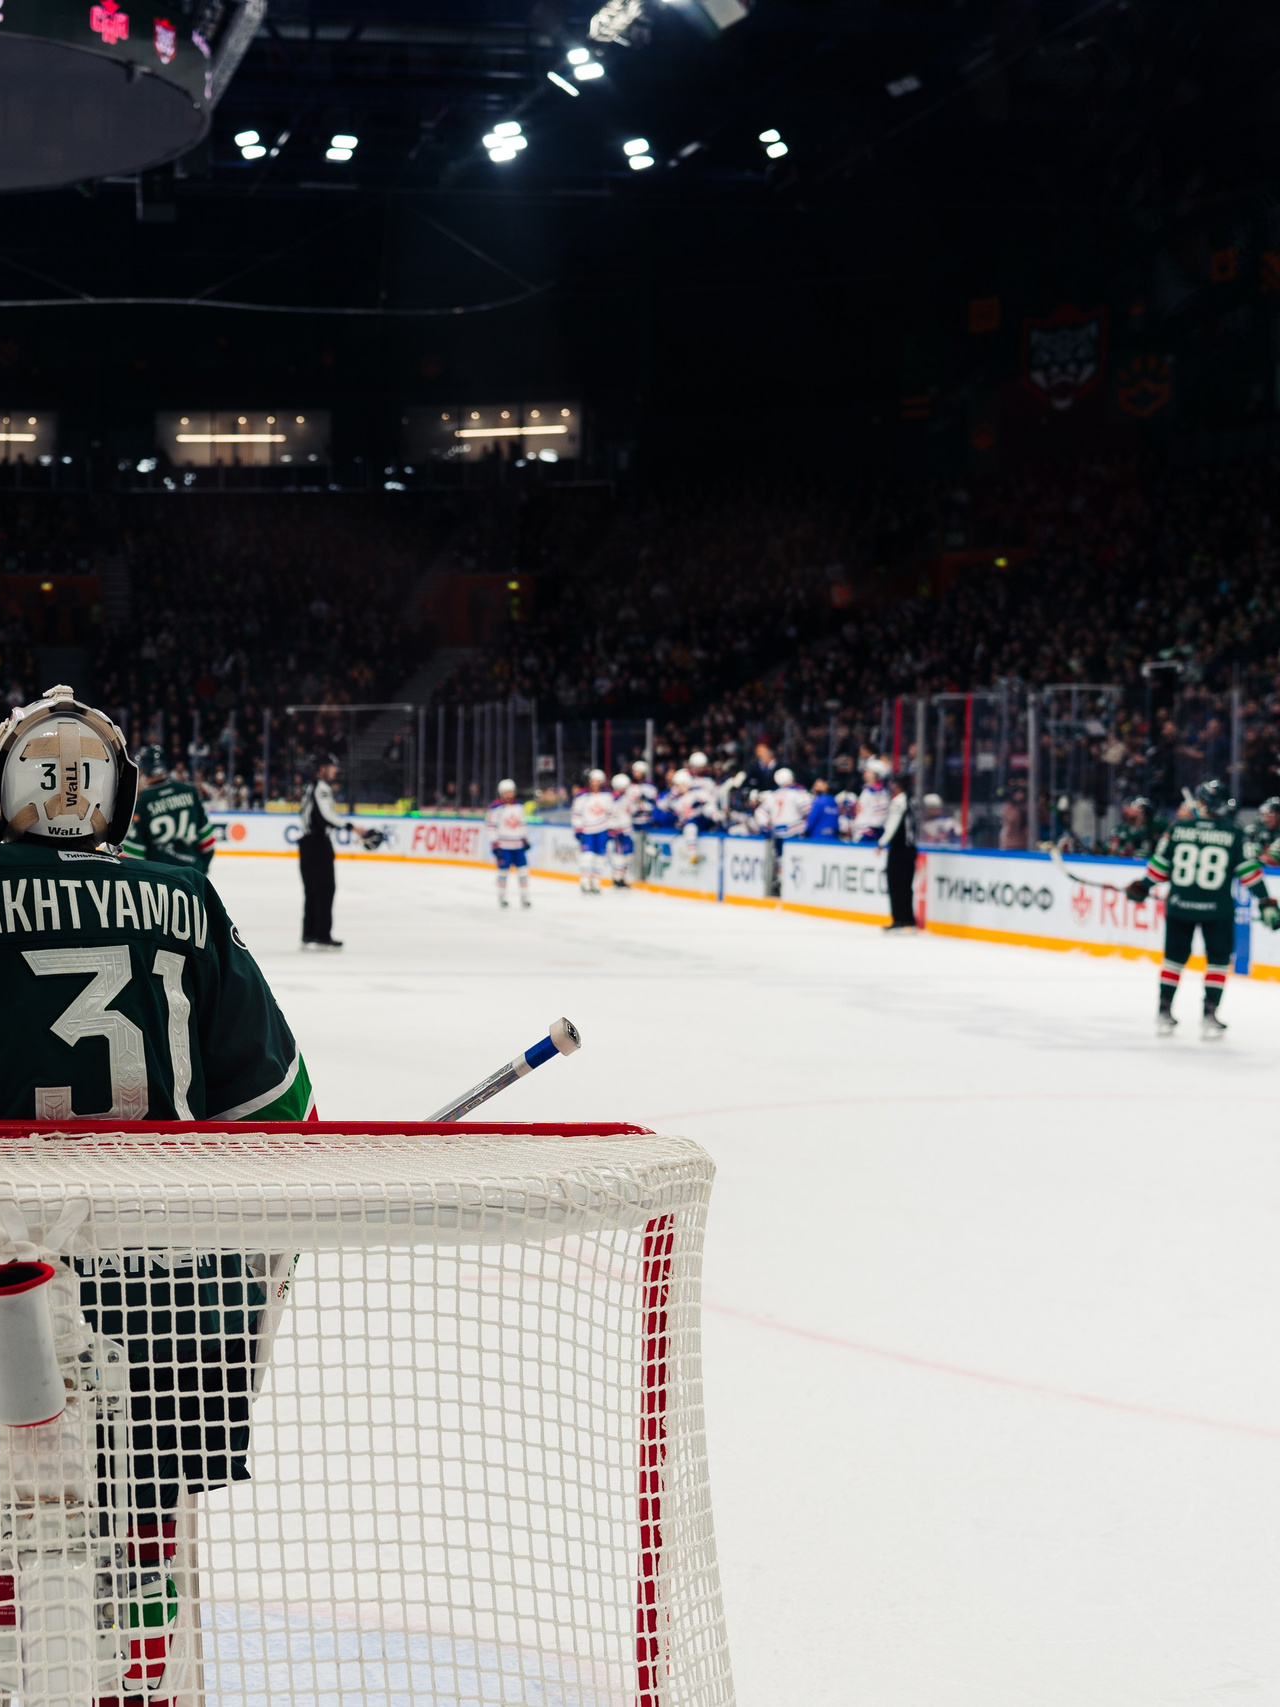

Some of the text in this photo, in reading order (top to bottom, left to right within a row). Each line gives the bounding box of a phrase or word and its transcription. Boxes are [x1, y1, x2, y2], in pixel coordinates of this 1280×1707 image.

[149, 810, 197, 847] 24
[411, 824, 480, 855] FONBET
[1171, 842, 1230, 891] 88
[934, 876, 1055, 911] ТИНЬКОФФ
[21, 945, 196, 1121] 31
